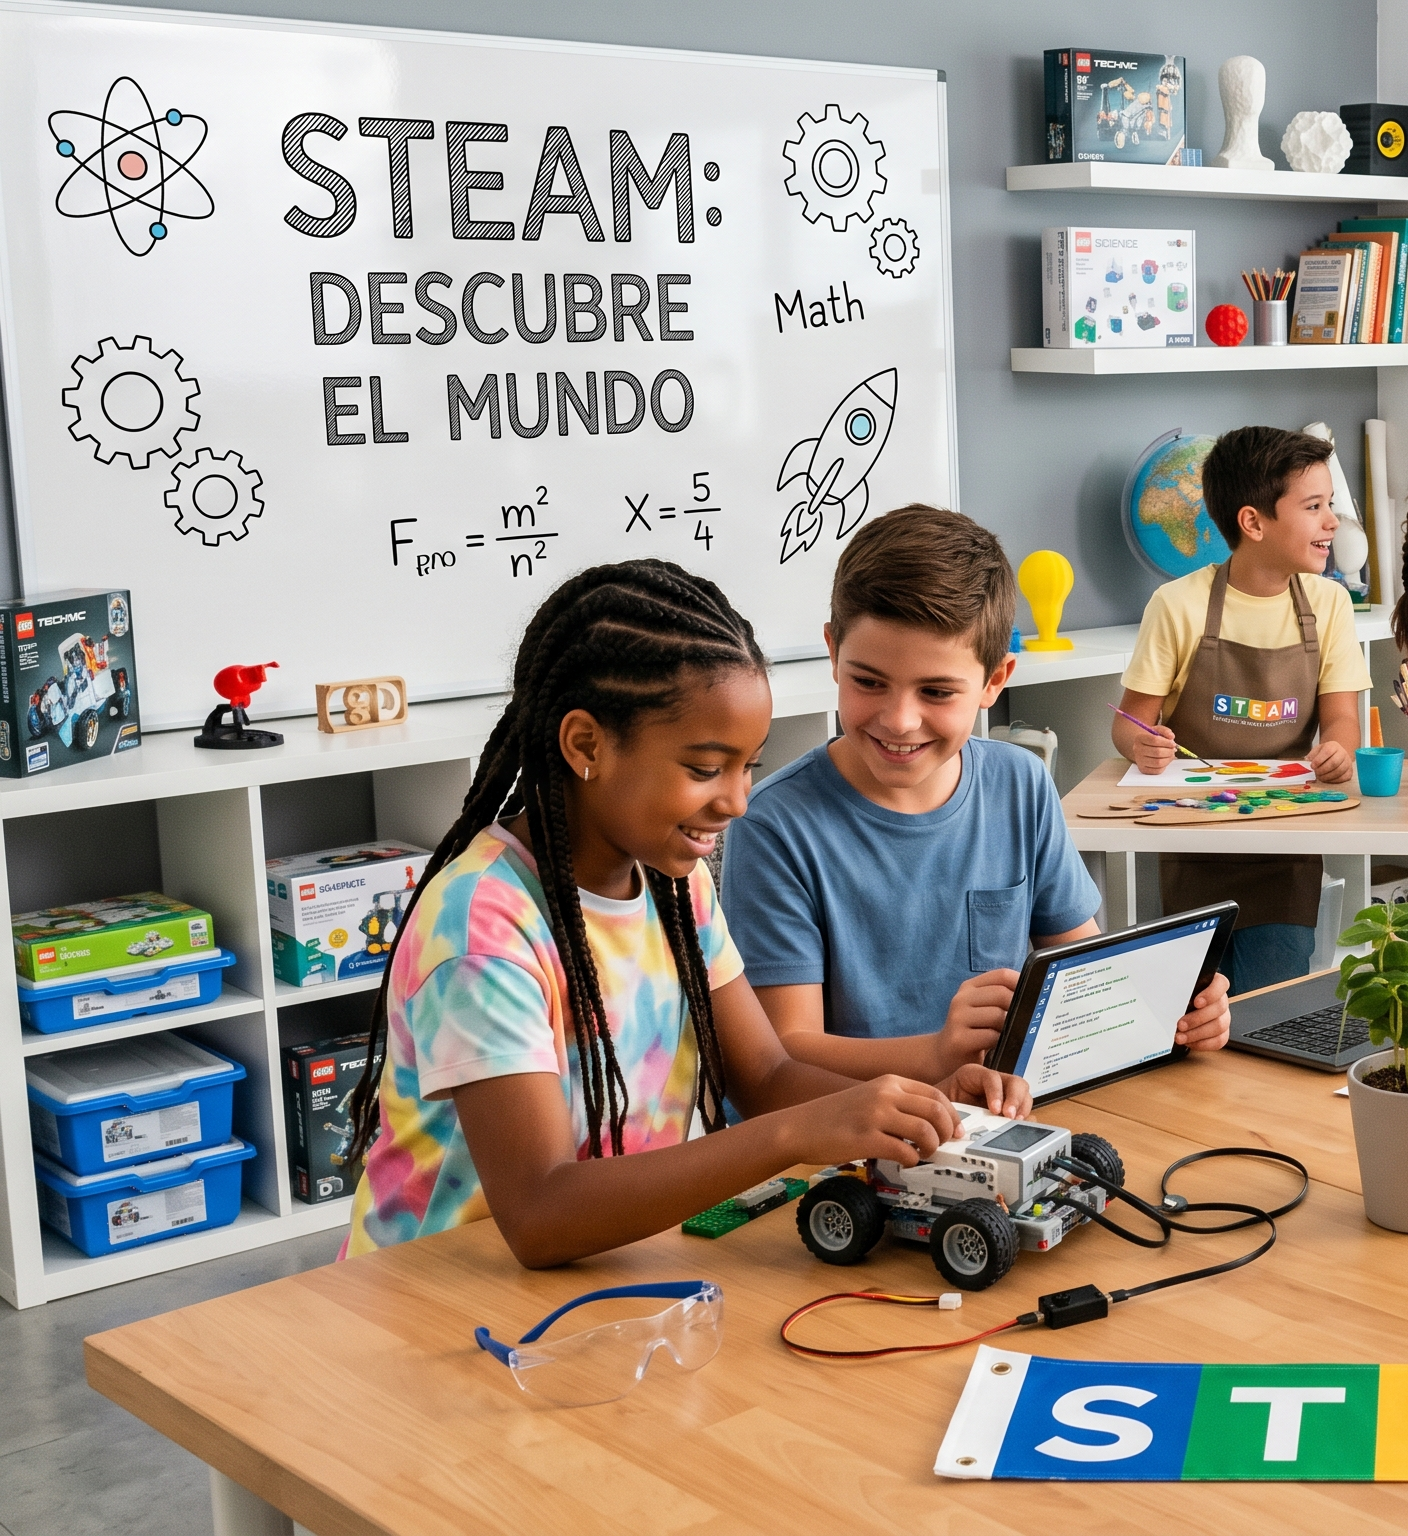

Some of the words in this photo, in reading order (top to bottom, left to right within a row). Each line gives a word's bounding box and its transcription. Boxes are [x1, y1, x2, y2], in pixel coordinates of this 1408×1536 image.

[281, 112, 723, 244] STEAM:
[309, 271, 695, 346] DESCUBRE
[774, 280, 865, 334] Math
[322, 375, 410, 447] EL
[446, 368, 695, 441] MUNDO
[1216, 697, 1295, 718] STEAM
